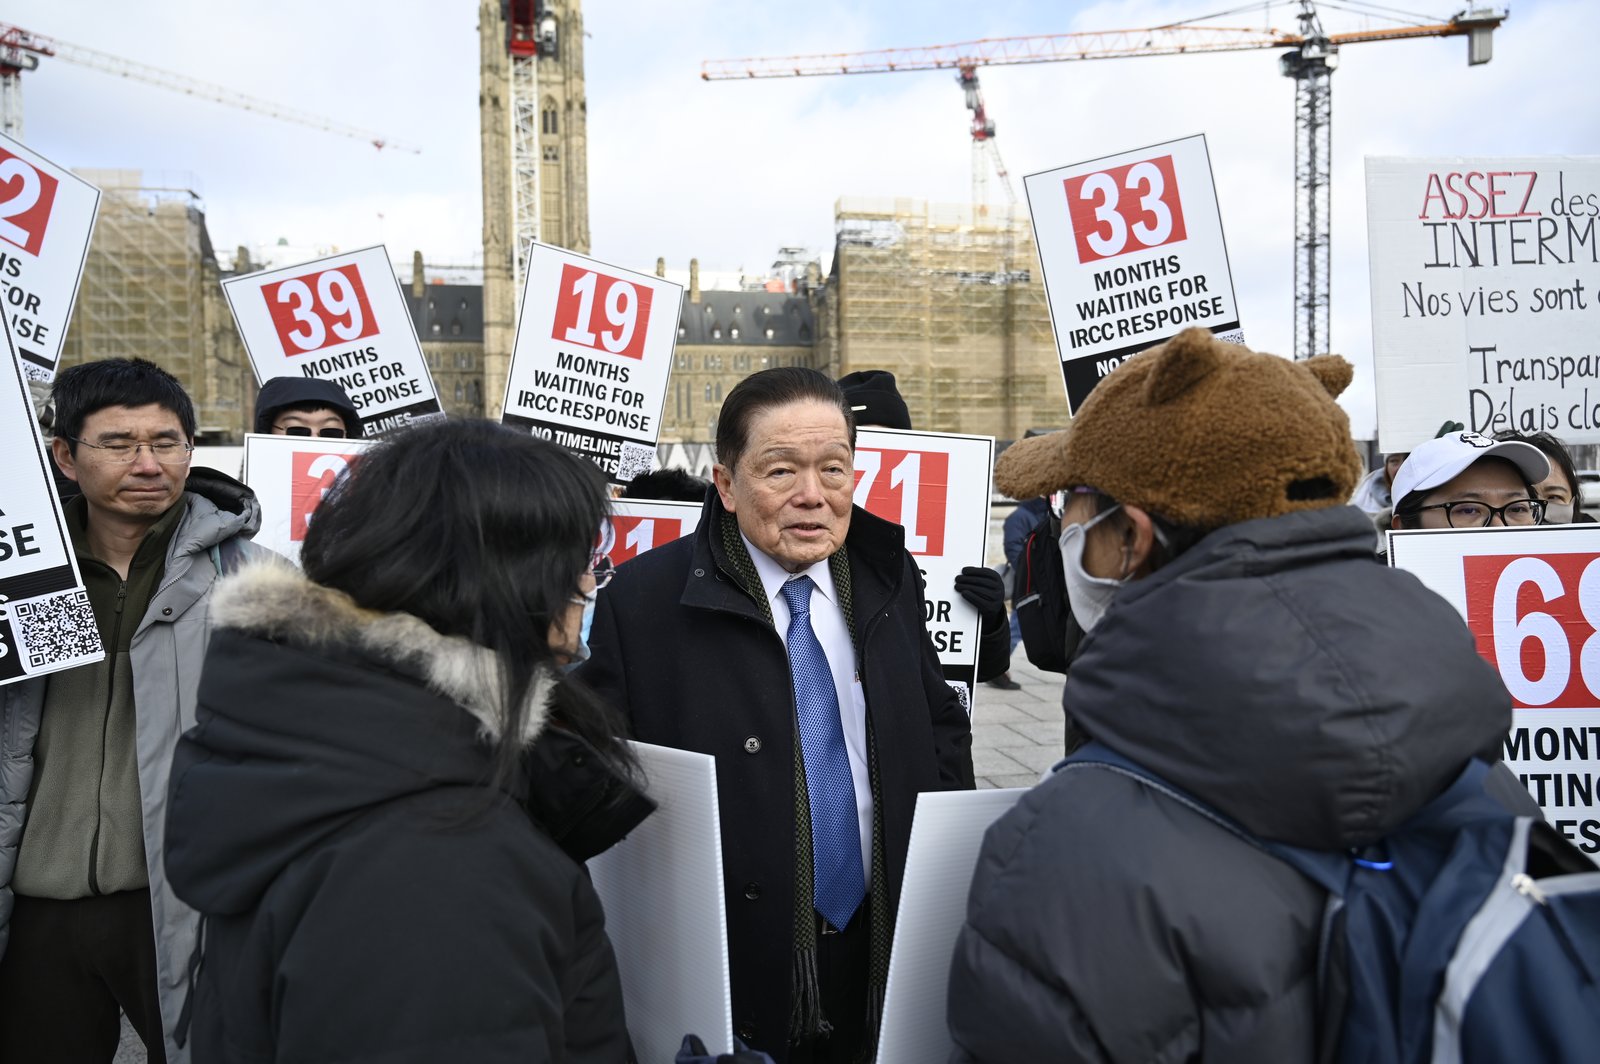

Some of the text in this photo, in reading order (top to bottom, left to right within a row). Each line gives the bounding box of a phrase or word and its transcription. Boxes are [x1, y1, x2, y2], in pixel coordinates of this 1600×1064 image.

[1080, 162, 1173, 257] 33
[1418, 171, 1600, 220] ASSEZ des
[1423, 217, 1600, 269] INTERM
[1093, 255, 1181, 291] MONTHS
[277, 270, 364, 351] 39
[565, 271, 638, 354] 19
[1076, 274, 1208, 321] WAITING FOR
[1401, 282, 1452, 318] Nos
[1458, 287, 1519, 317] vies
[1530, 279, 1587, 313] sont
[1069, 296, 1225, 349] IRCC RESPONSE
[301, 346, 380, 379] MONTHS
[369, 362, 405, 384] FOR
[556, 352, 630, 383] MONTHS
[534, 370, 645, 409] WAITING FOR
[362, 412, 413, 438] ELINES
[517, 390, 651, 432] IRCC RESPONSE
[1469, 387, 1558, 436] Délais
[531, 426, 622, 456] NO TIMELINE
